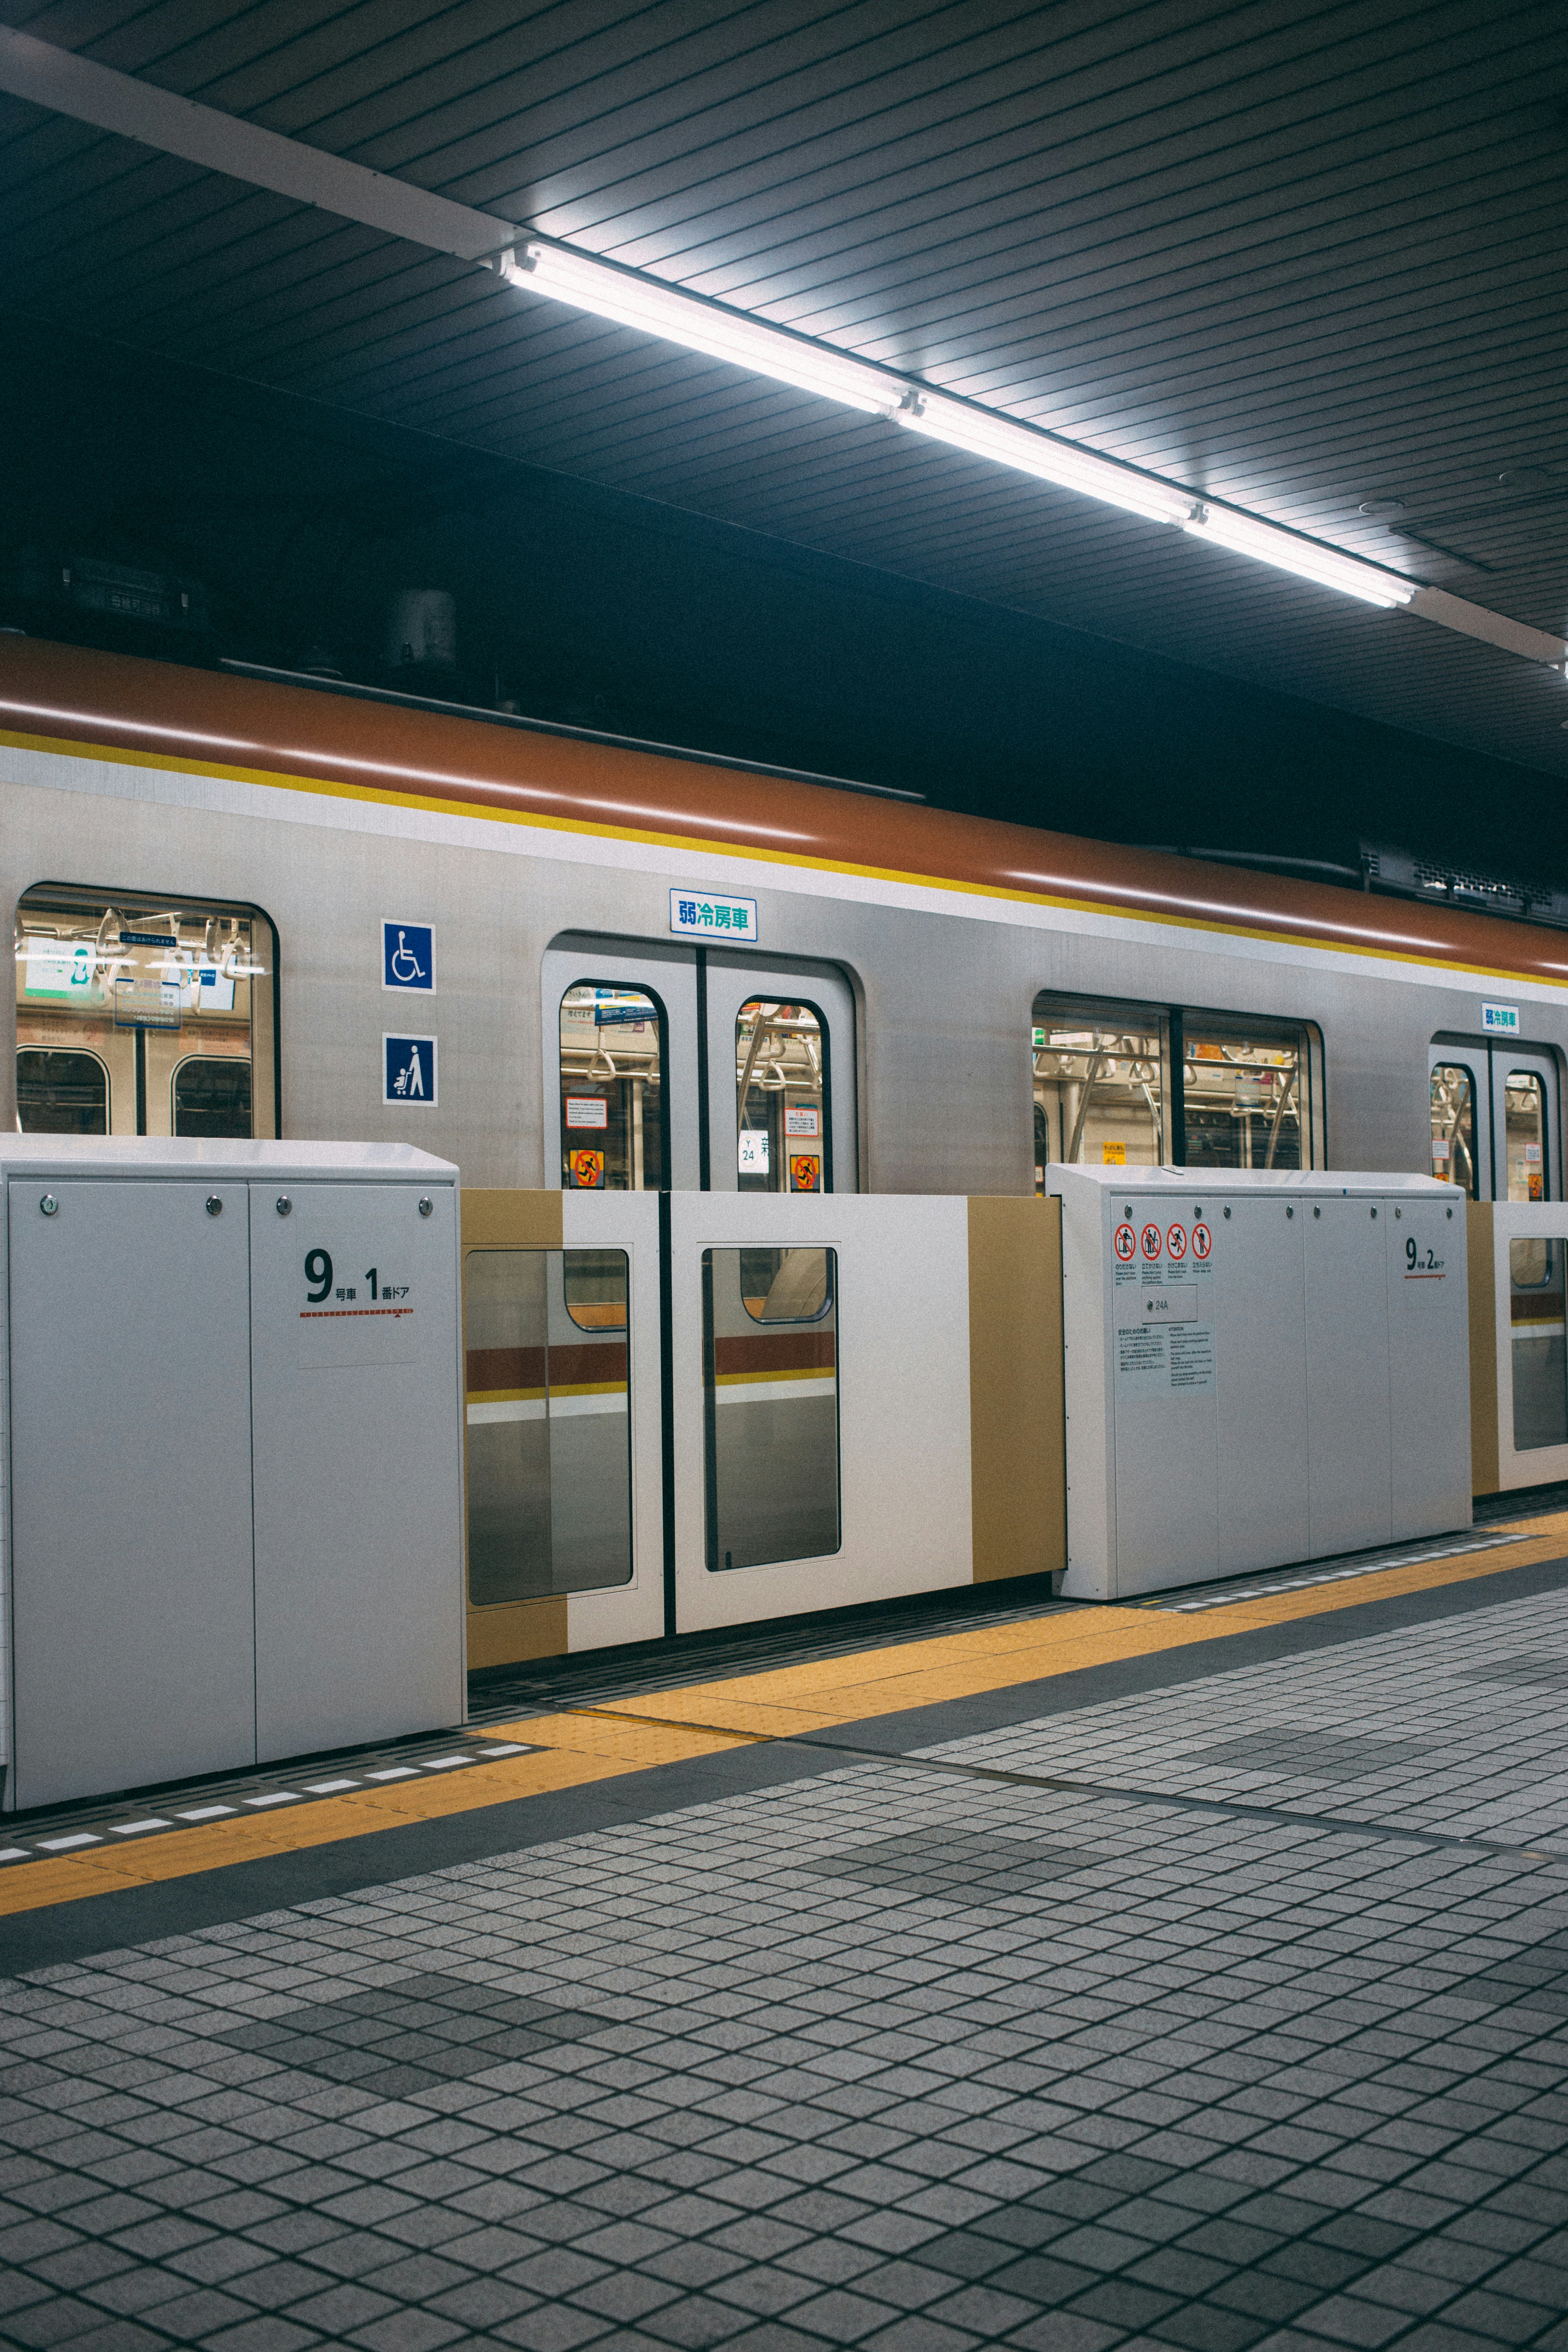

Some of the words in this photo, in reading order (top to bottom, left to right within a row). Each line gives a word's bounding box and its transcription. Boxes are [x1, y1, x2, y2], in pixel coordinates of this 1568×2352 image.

[679, 900, 748, 931] 弱冷房車
[1486, 1009, 1516, 1027] 弱冷房車
[743, 1150, 754, 1161] 24
[1156, 1300, 1168, 1310] 24A
